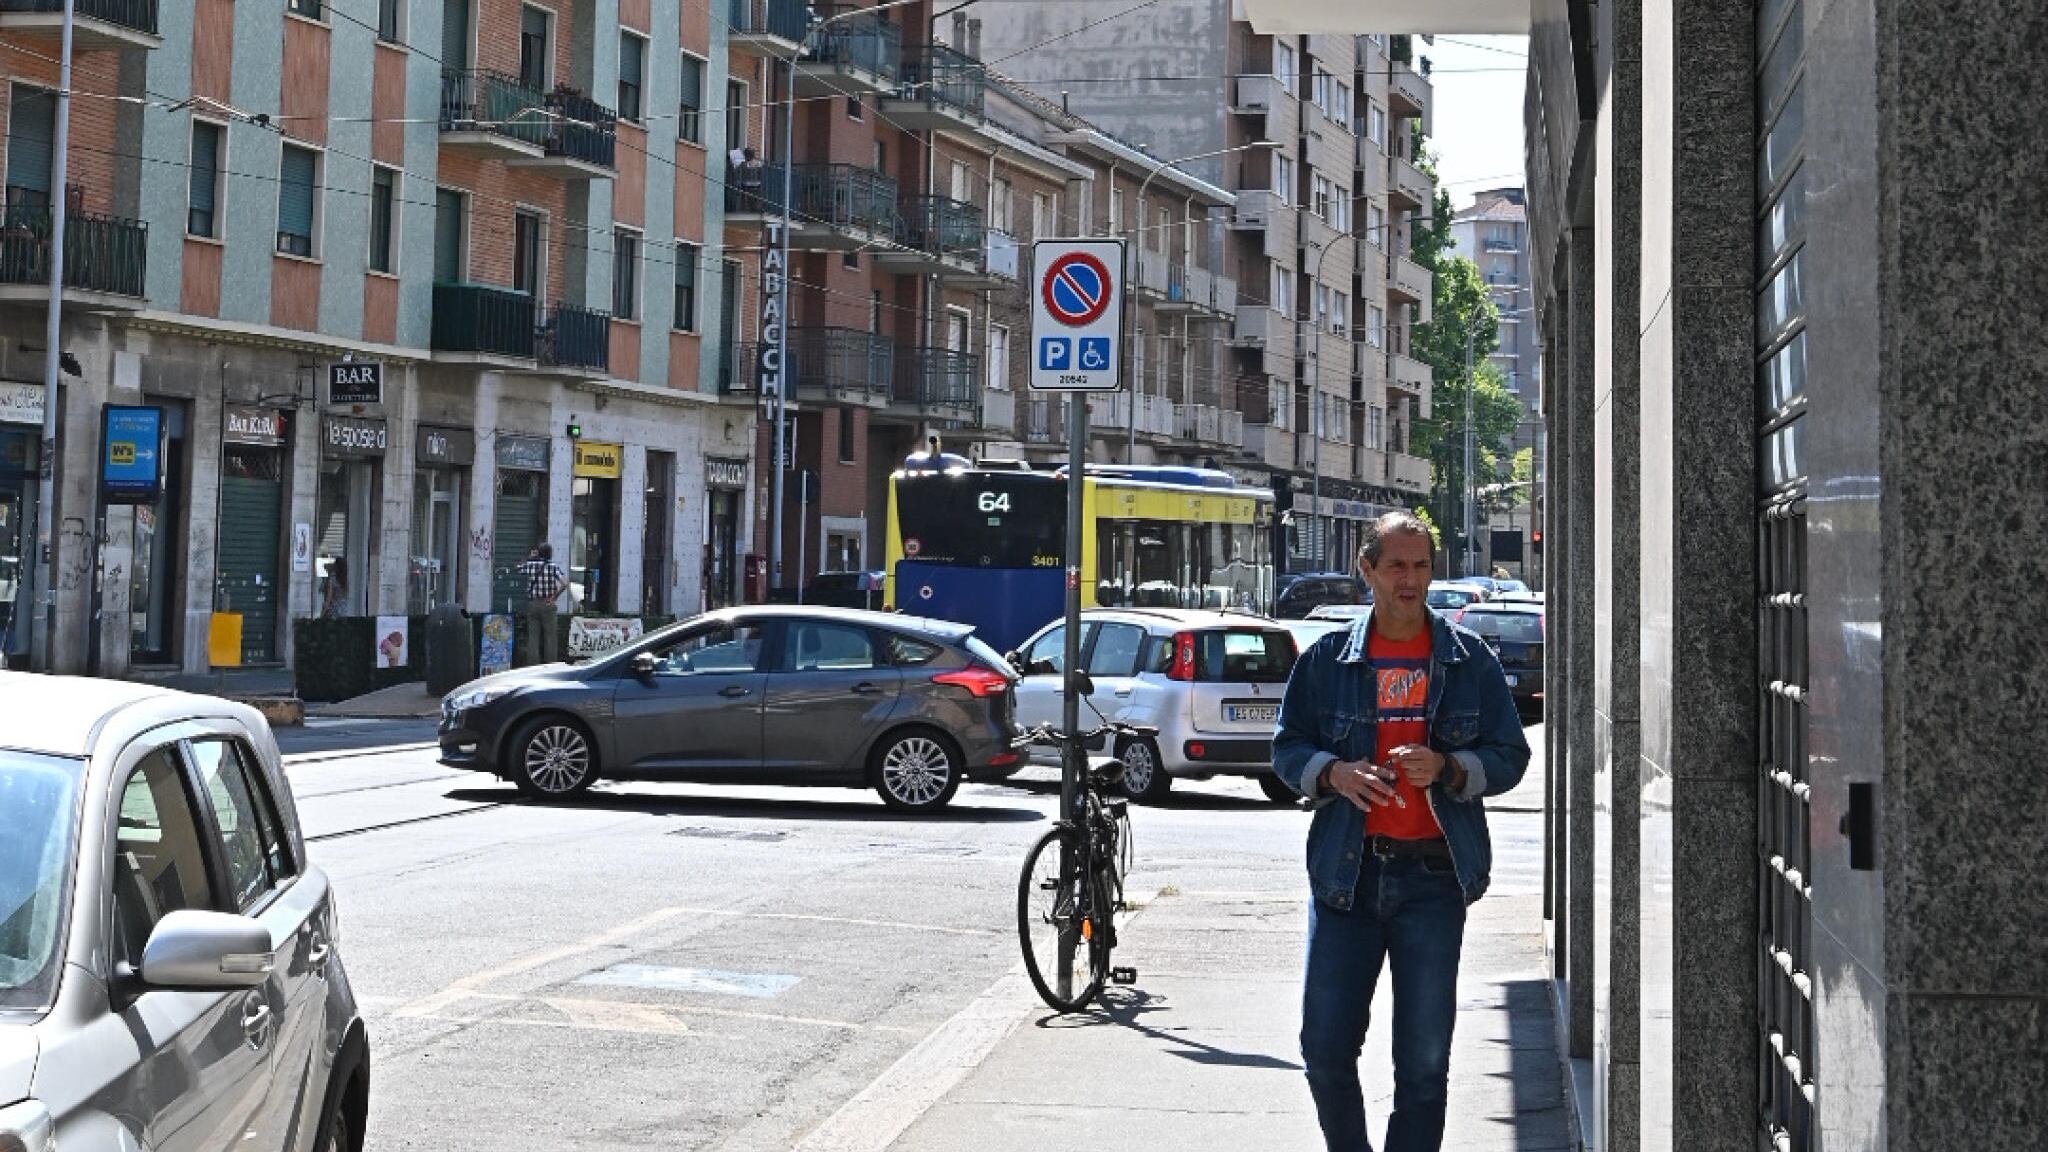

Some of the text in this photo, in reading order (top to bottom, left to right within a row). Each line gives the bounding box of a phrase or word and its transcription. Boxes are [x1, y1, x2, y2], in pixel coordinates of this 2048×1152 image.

[761, 224, 782, 420] TABACCHI
[1046, 341, 1065, 367] P
[335, 367, 376, 385] BAR
[978, 491, 1011, 512] 64
[1032, 555, 1059, 567] 3401
